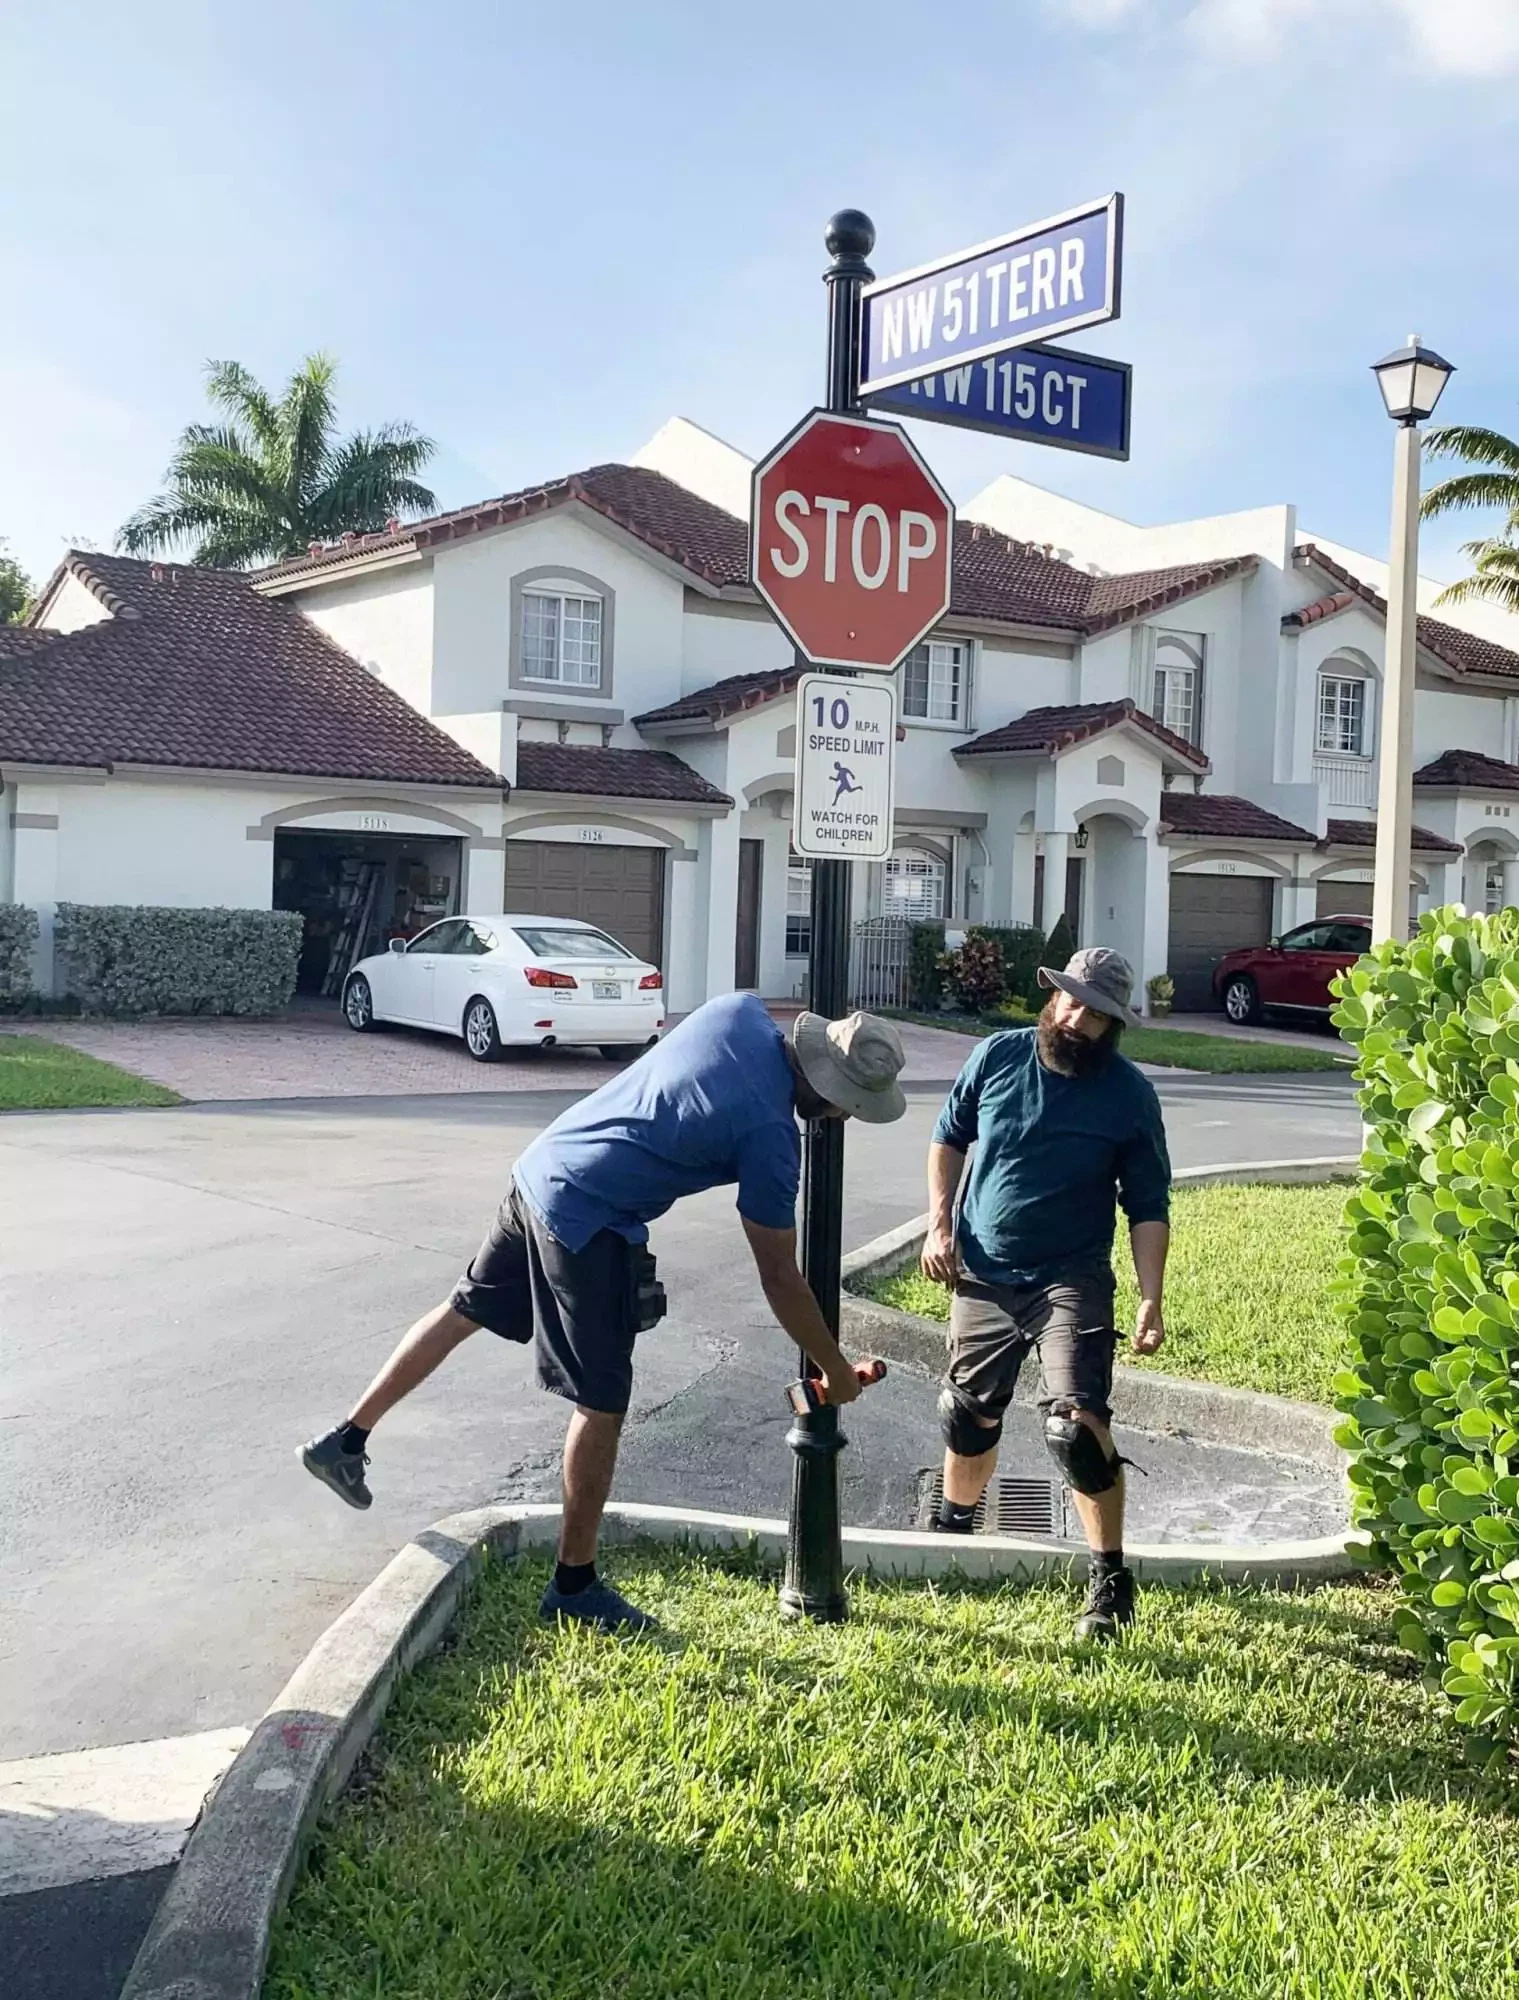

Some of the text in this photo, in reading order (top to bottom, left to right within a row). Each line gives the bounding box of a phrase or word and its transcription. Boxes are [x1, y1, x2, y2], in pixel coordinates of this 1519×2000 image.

[881, 237, 1085, 363] NW 51 TERR
[982, 357, 1036, 420] 115
[1042, 370, 1087, 430] CT
[770, 489, 937, 593] STOP
[812, 696, 850, 730] 10
[809, 734, 885, 756] SPEED LIMIT
[811, 809, 879, 826] WATCH FOR
[815, 827, 873, 842] CHILDREN
